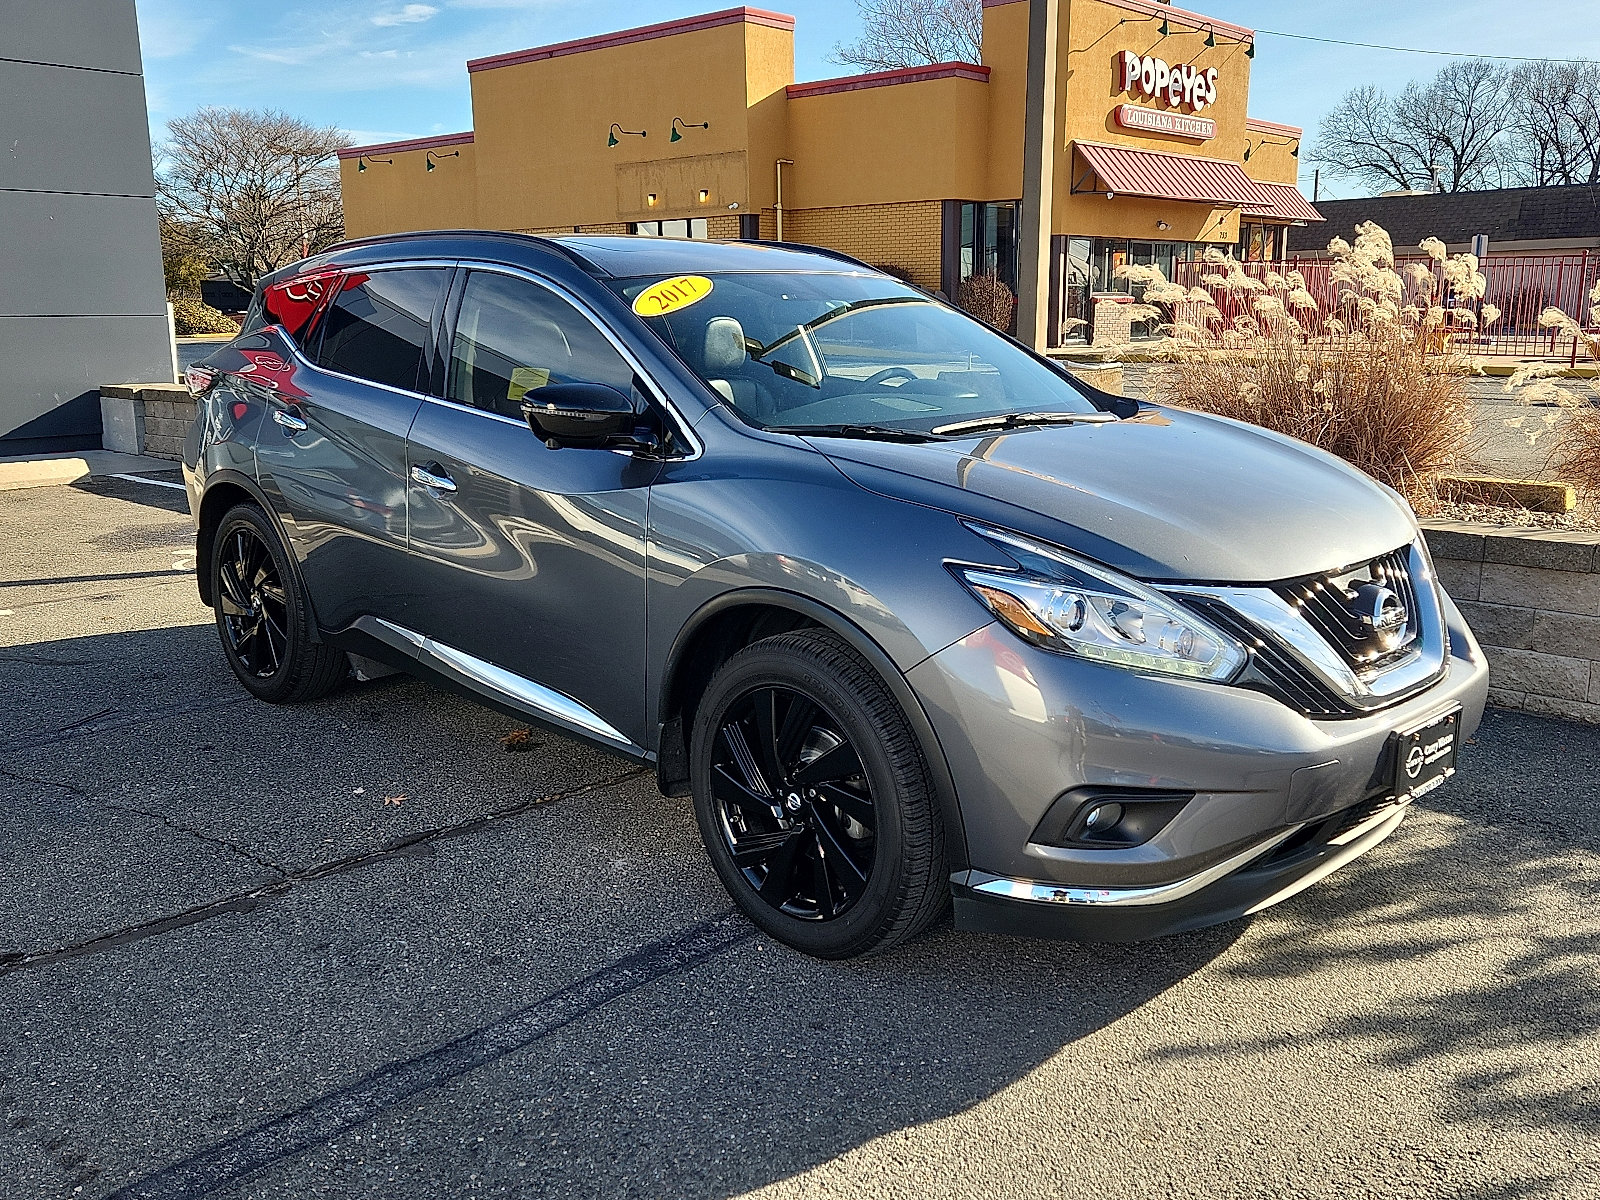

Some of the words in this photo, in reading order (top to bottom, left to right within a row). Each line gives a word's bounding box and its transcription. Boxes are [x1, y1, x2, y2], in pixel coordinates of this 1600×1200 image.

[1127, 110, 1173, 129] LOUISIANA
[1174, 118, 1213, 136] KITCHEN
[649, 279, 696, 310] 2017
